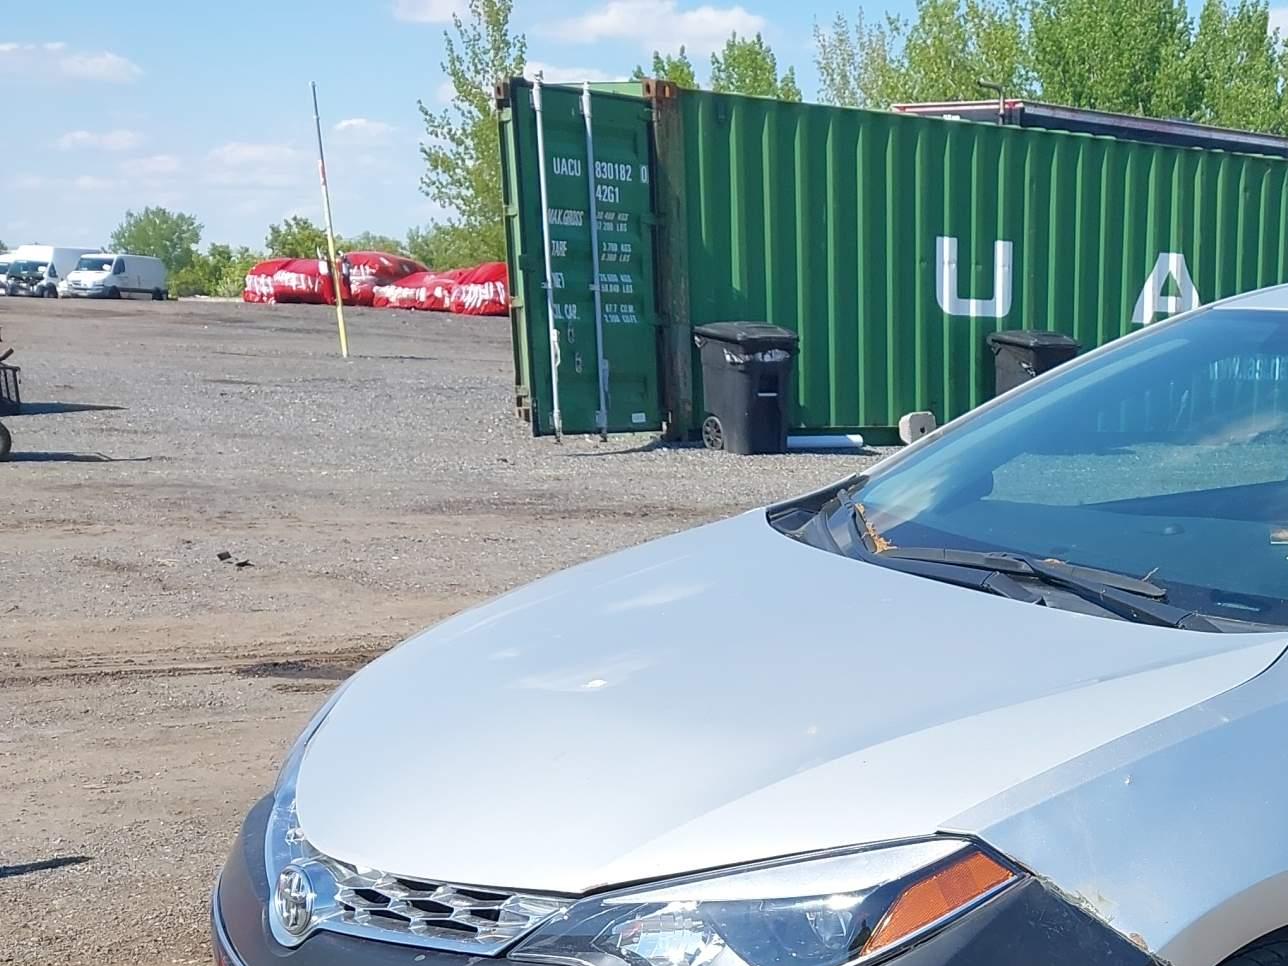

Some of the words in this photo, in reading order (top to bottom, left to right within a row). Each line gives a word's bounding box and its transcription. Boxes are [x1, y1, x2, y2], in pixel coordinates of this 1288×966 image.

[553, 157, 581, 176] UACU
[595, 161, 632, 181] 830182
[596, 184, 619, 203] 42G1
